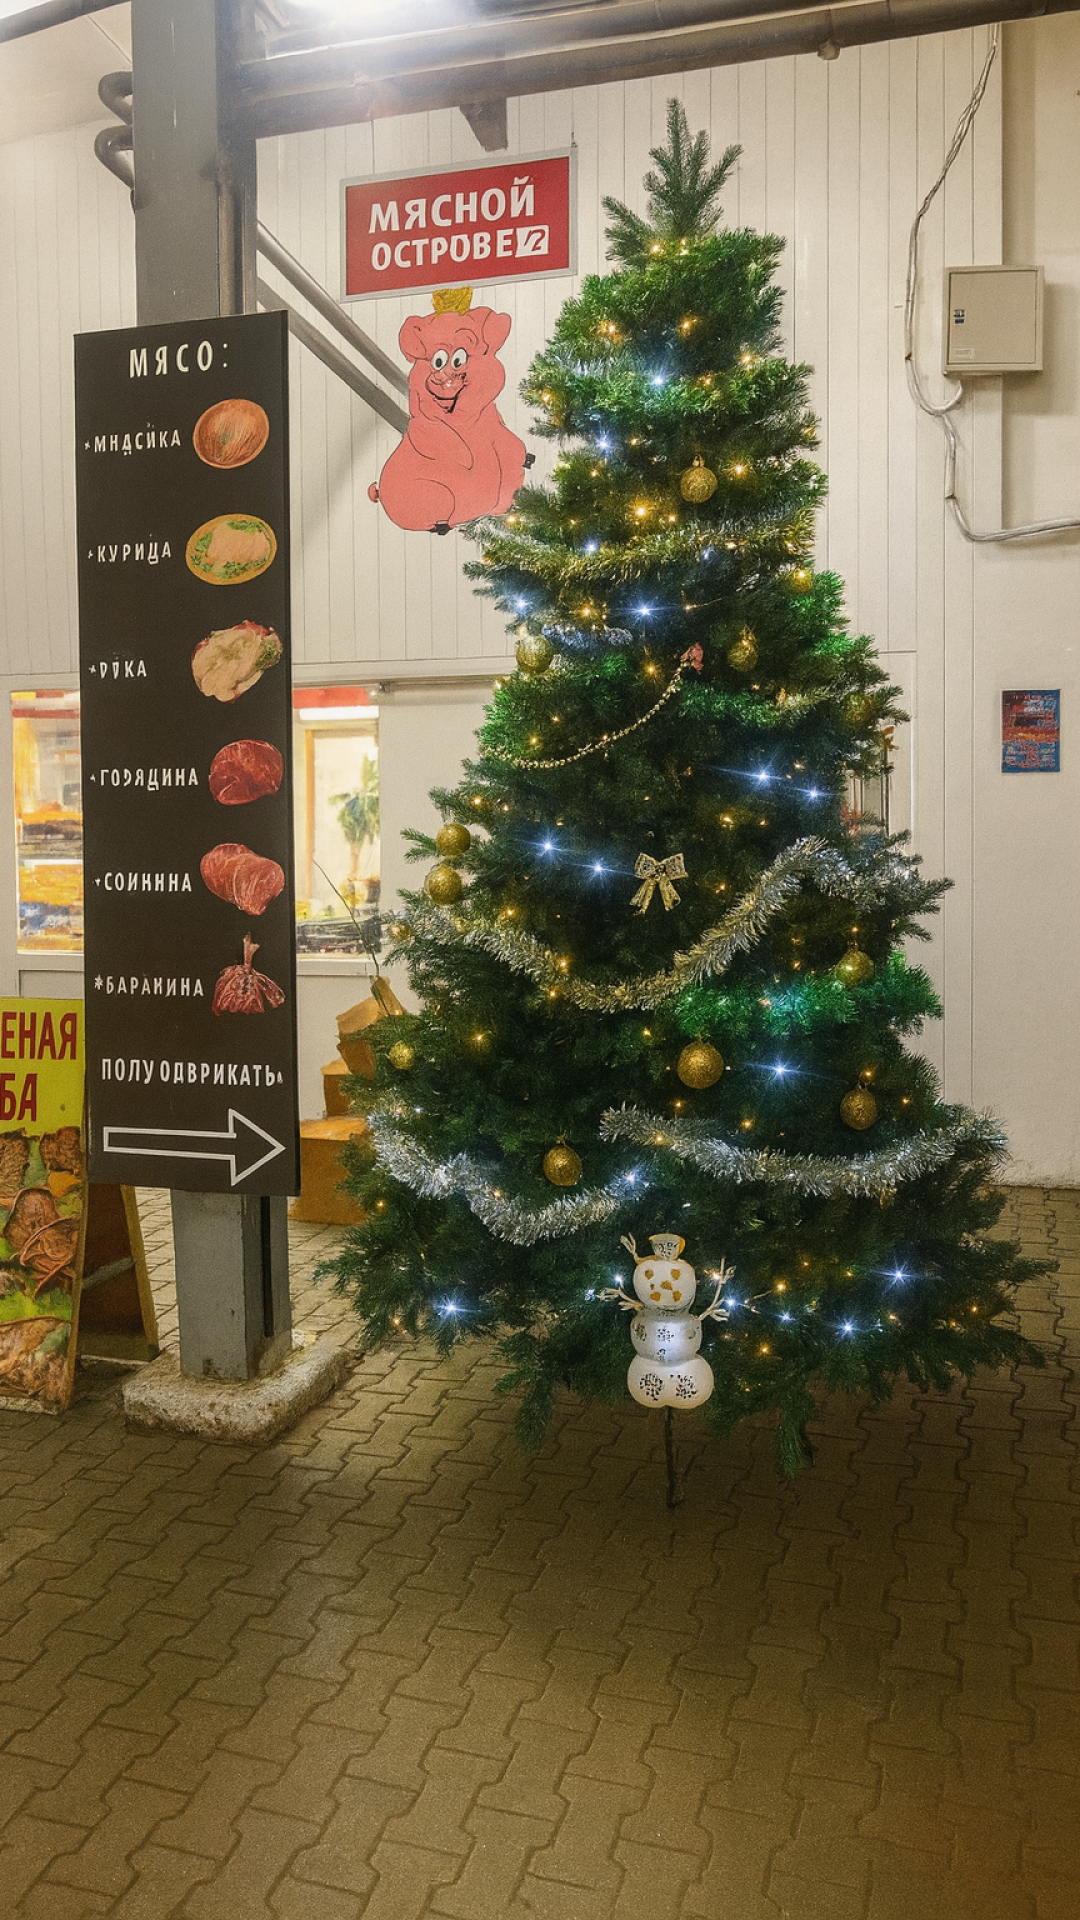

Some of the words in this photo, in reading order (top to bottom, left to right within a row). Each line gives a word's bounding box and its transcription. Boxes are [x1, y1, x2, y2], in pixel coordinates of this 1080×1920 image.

[368, 175, 535, 234] МЯСНОЙ
[129, 340, 229, 378] МЯСО:
[1, 1011, 77, 1060] ЕНАЯ
[0, 1073, 38, 1122] БА
